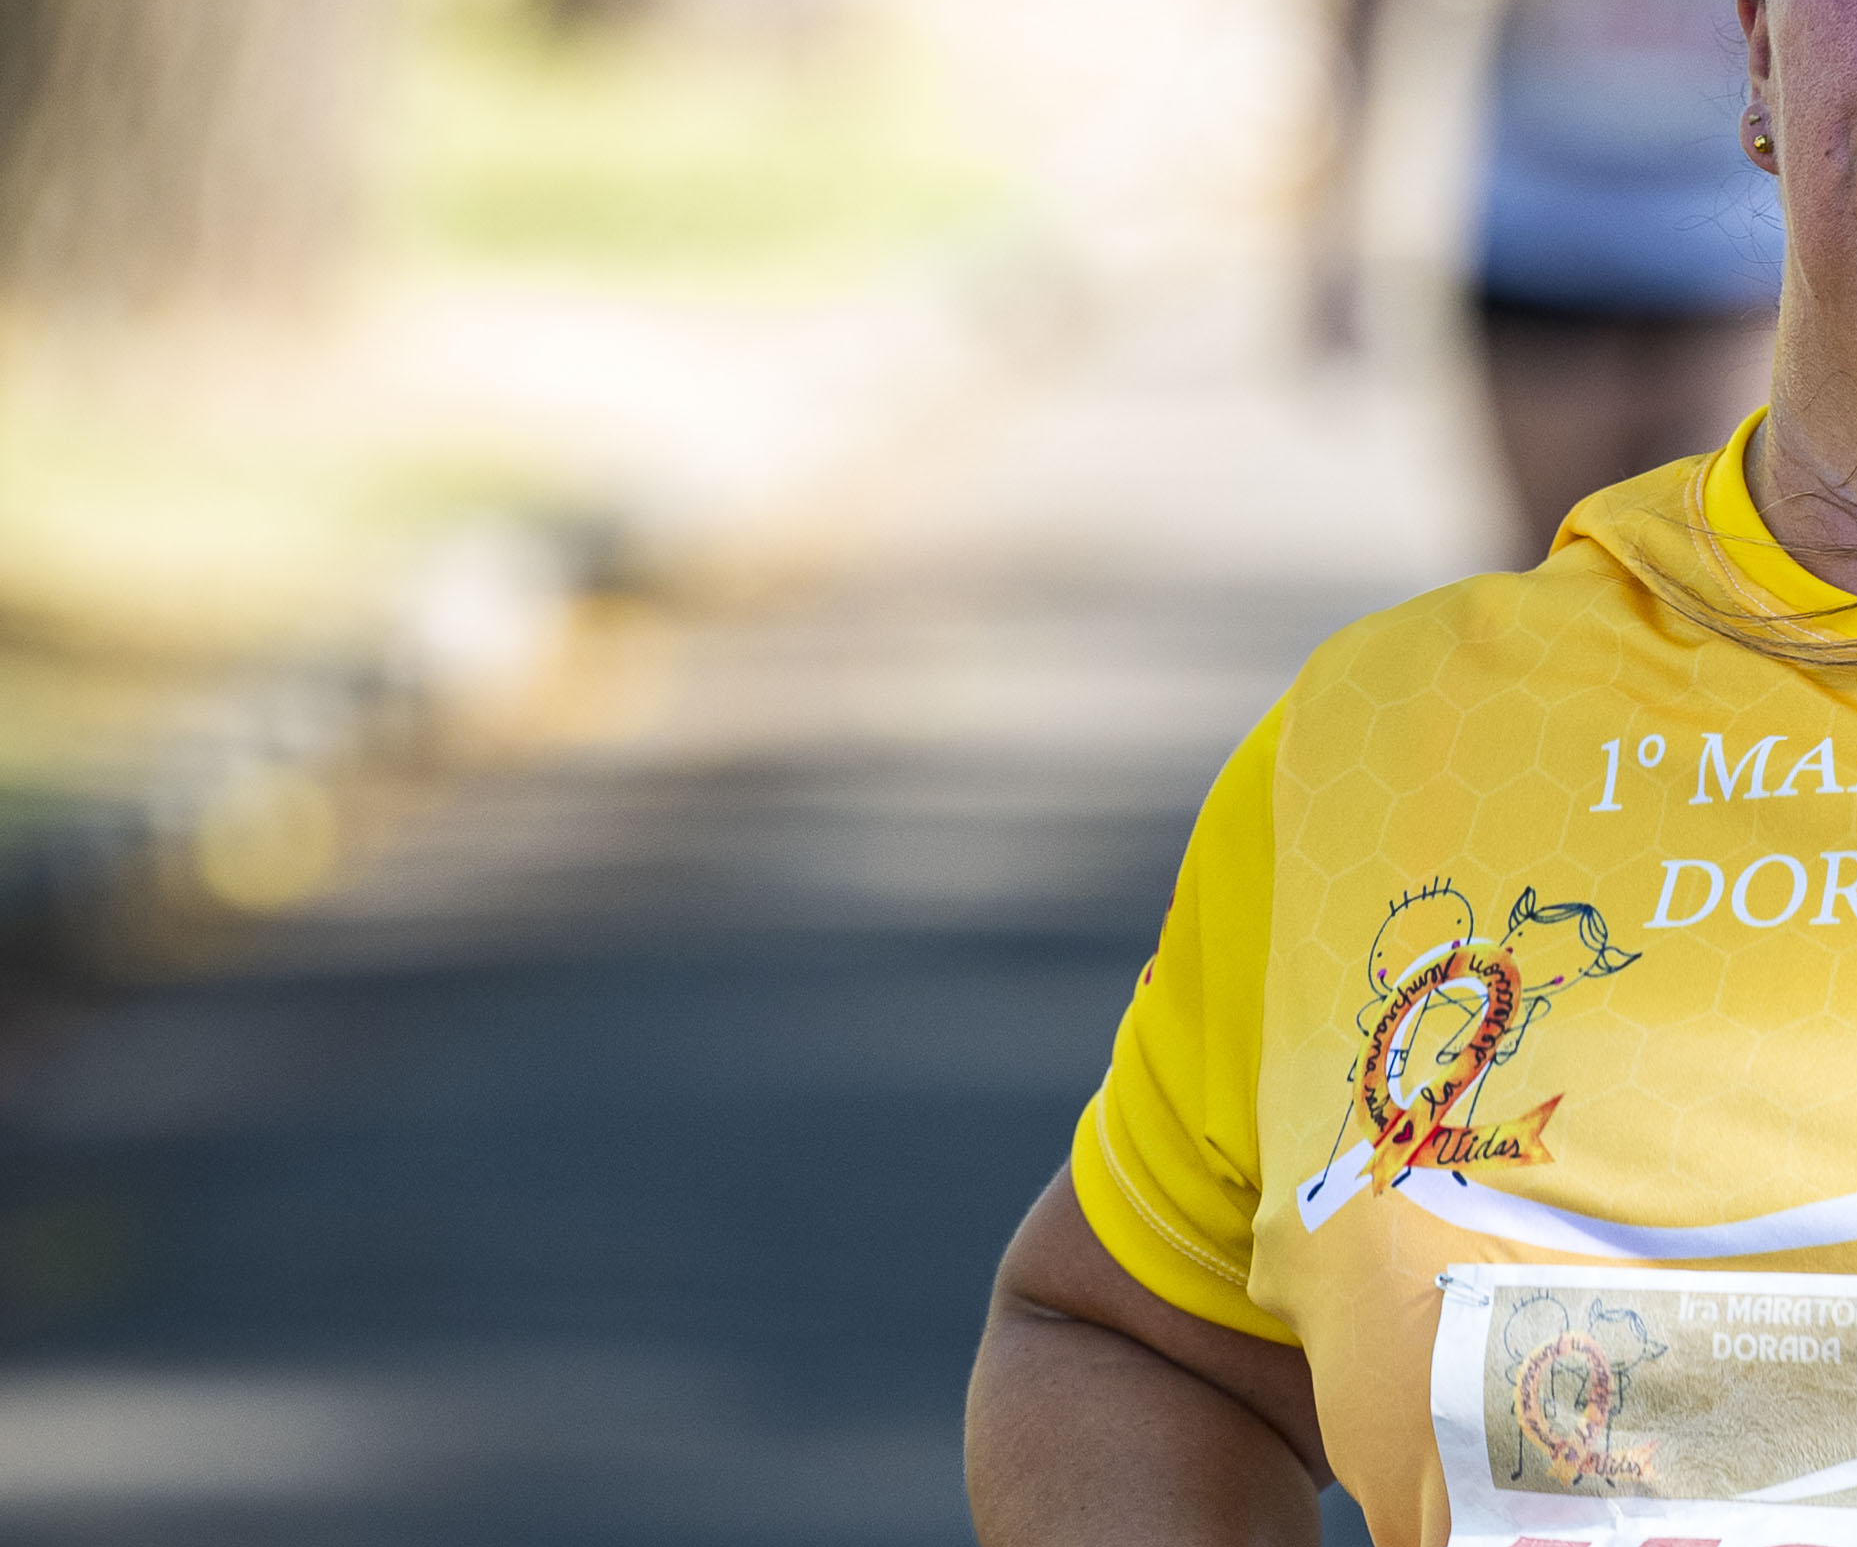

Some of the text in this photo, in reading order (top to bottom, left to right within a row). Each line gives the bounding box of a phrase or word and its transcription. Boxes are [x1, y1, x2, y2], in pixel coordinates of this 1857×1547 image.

[1365, 952, 1457, 1076] temprana
[1421, 1080, 1463, 1122] la
[1432, 1124, 1522, 1165] Vidas
[1712, 1331, 1842, 1364] DORADA
